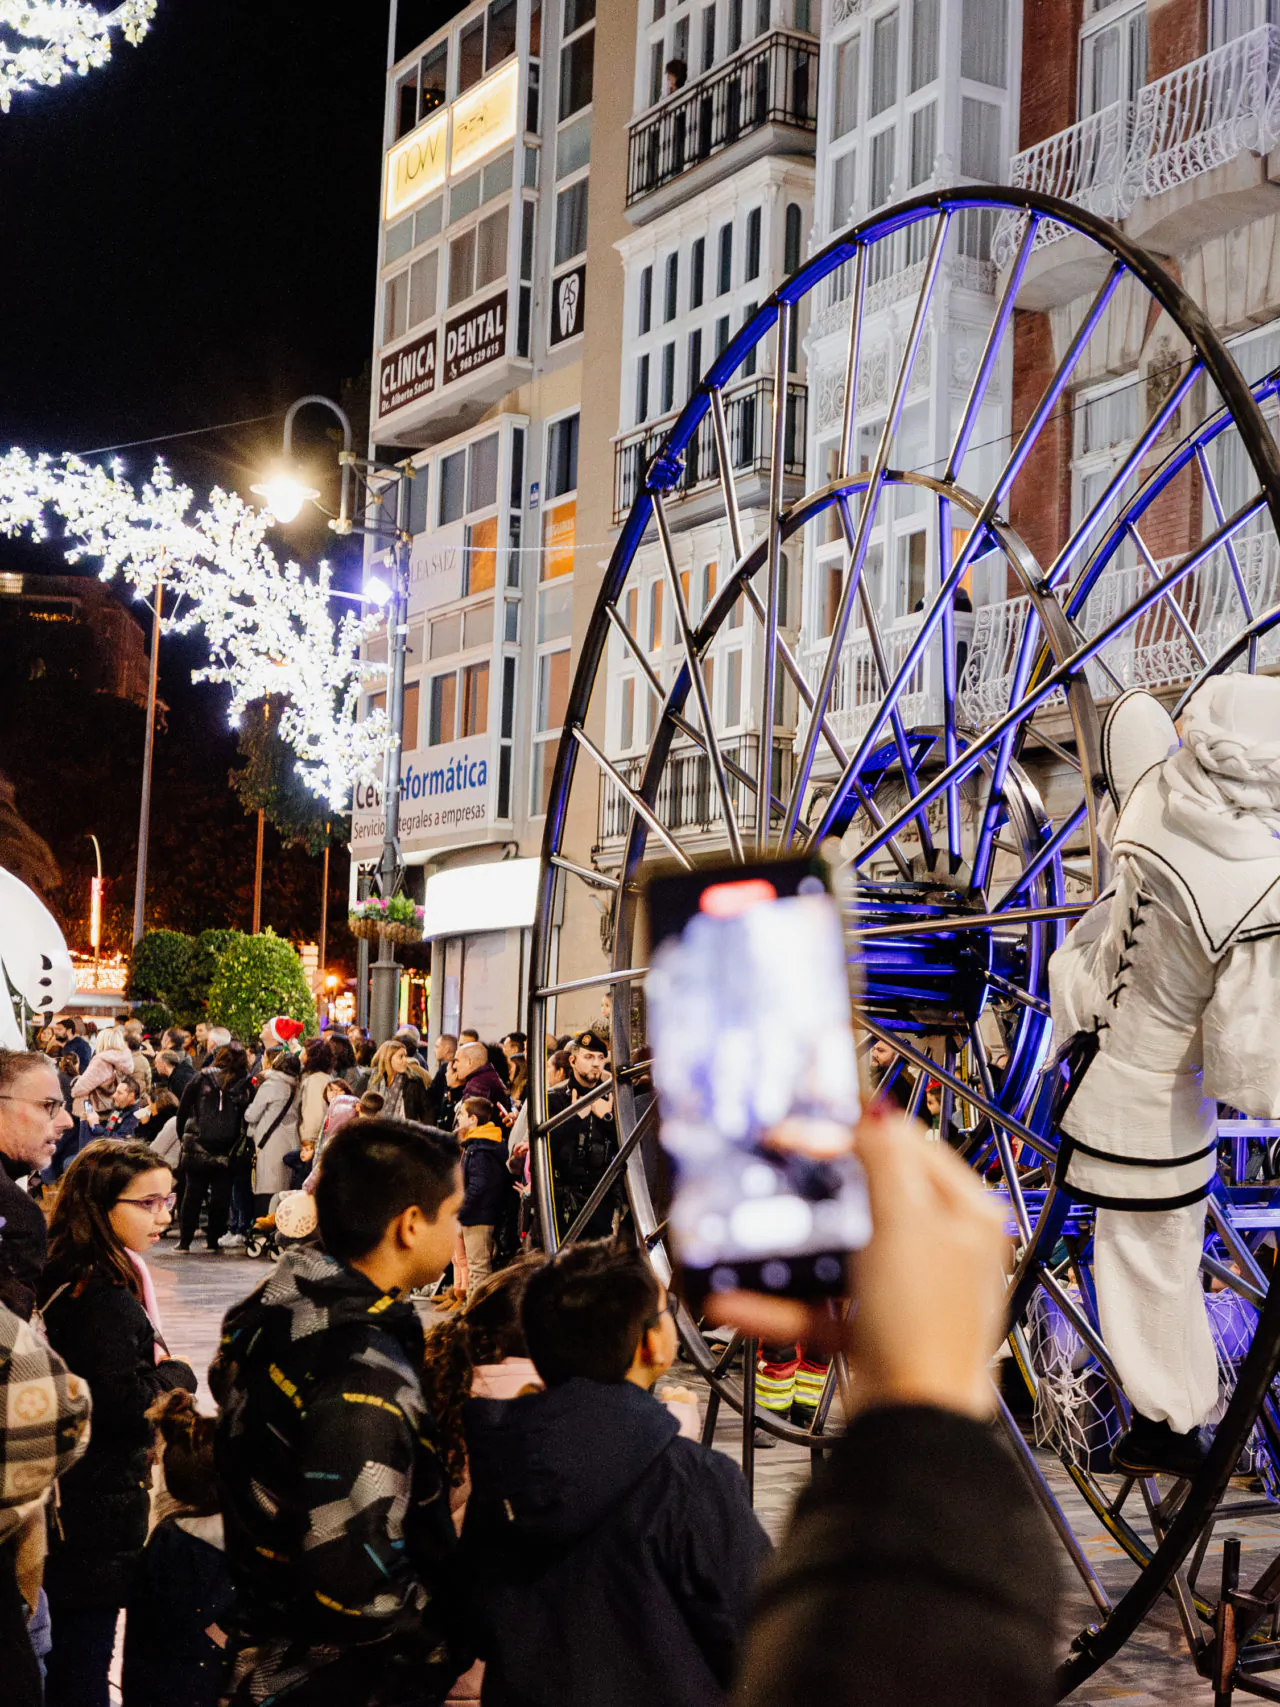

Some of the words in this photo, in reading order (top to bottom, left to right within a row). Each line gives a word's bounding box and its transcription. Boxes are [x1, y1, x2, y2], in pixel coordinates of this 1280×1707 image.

[446, 305, 504, 362] DENTAL
[381, 342, 435, 395] CLÍNICA
[354, 818, 386, 840] Servicio
[434, 812, 440, 826] a
[441, 803, 486, 828] empresas
